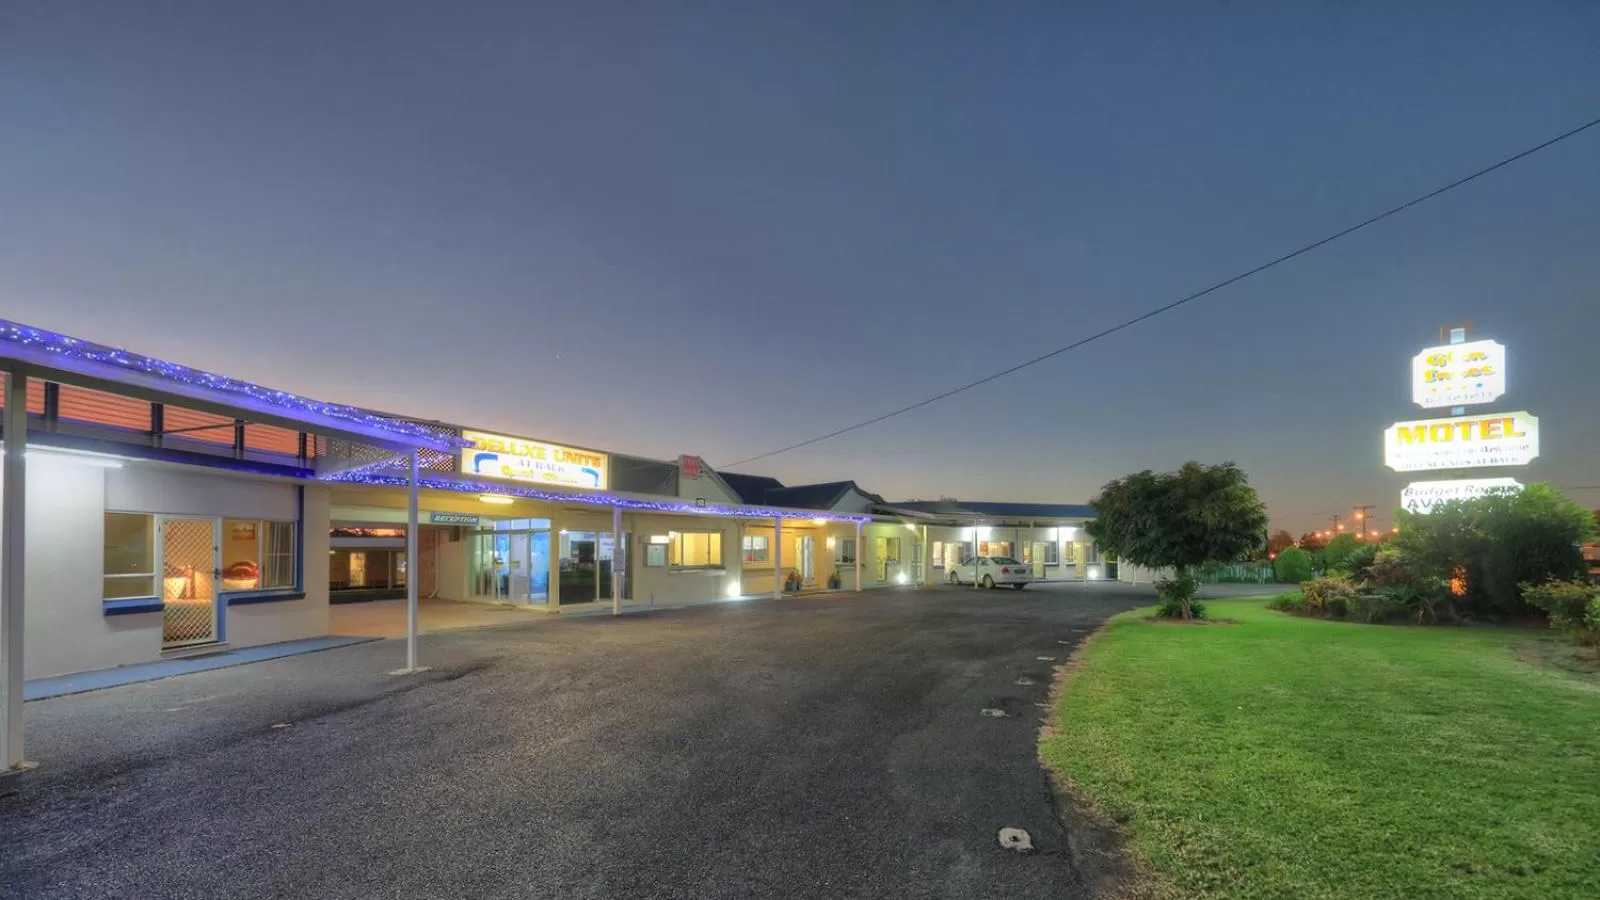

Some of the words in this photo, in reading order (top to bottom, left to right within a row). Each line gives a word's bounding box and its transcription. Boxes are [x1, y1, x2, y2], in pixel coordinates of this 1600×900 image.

[1397, 417, 1525, 445] MOTEL
[472, 436, 547, 460] DELUXE
[553, 449, 602, 468] UNITS
[1404, 486, 1460, 497] Budget
[434, 515, 478, 524] RECEPTION
